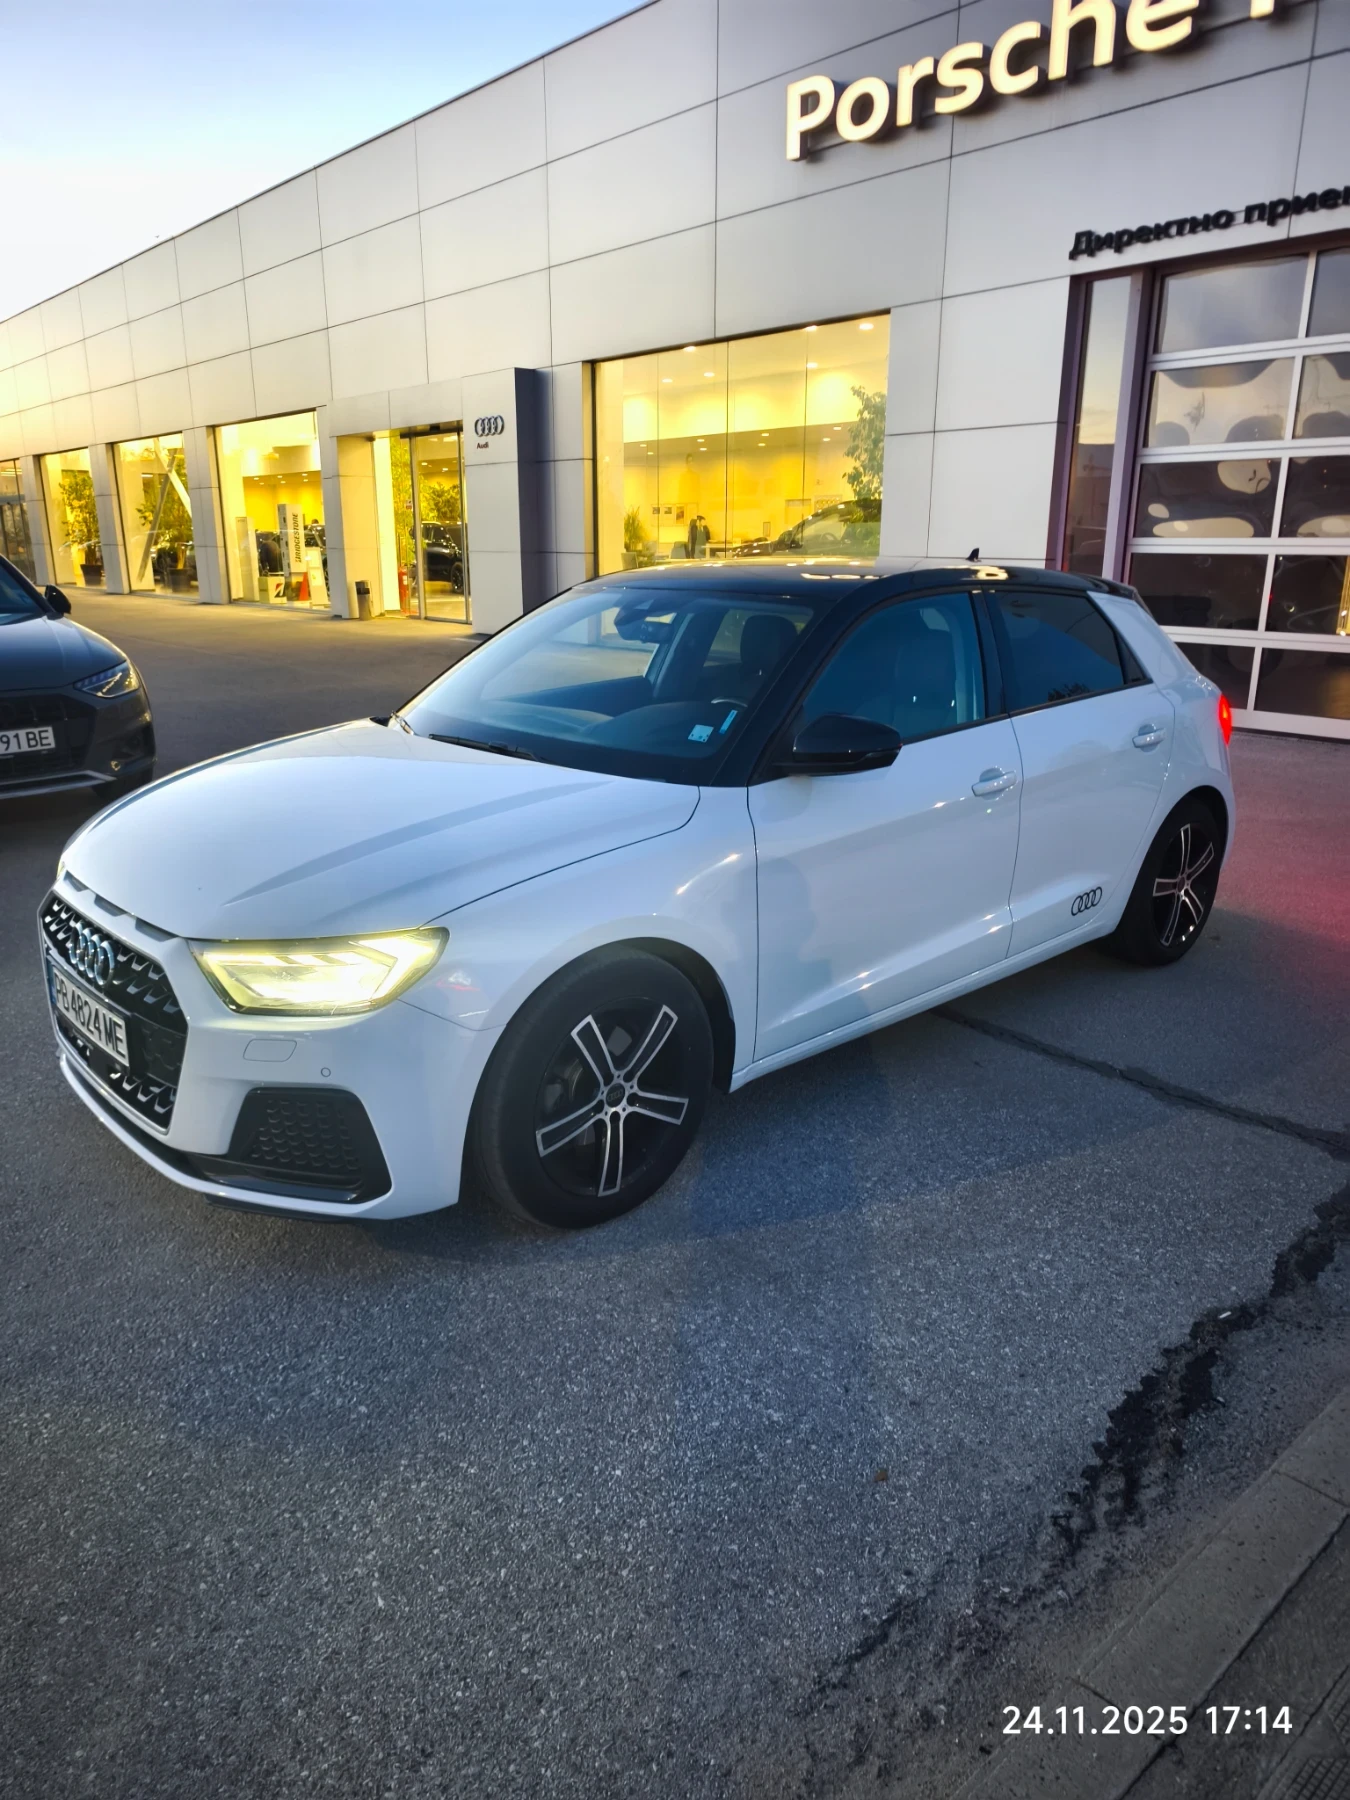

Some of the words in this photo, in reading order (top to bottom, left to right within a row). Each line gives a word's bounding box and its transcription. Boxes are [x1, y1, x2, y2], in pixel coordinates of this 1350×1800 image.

[786, 0, 1199, 160] Porsche
[1069, 209, 1235, 260] Директно
[1243, 184, 1350, 227] прие
[476, 441, 489, 449] Audi
[291, 512, 302, 563] BRIDGESTONE
